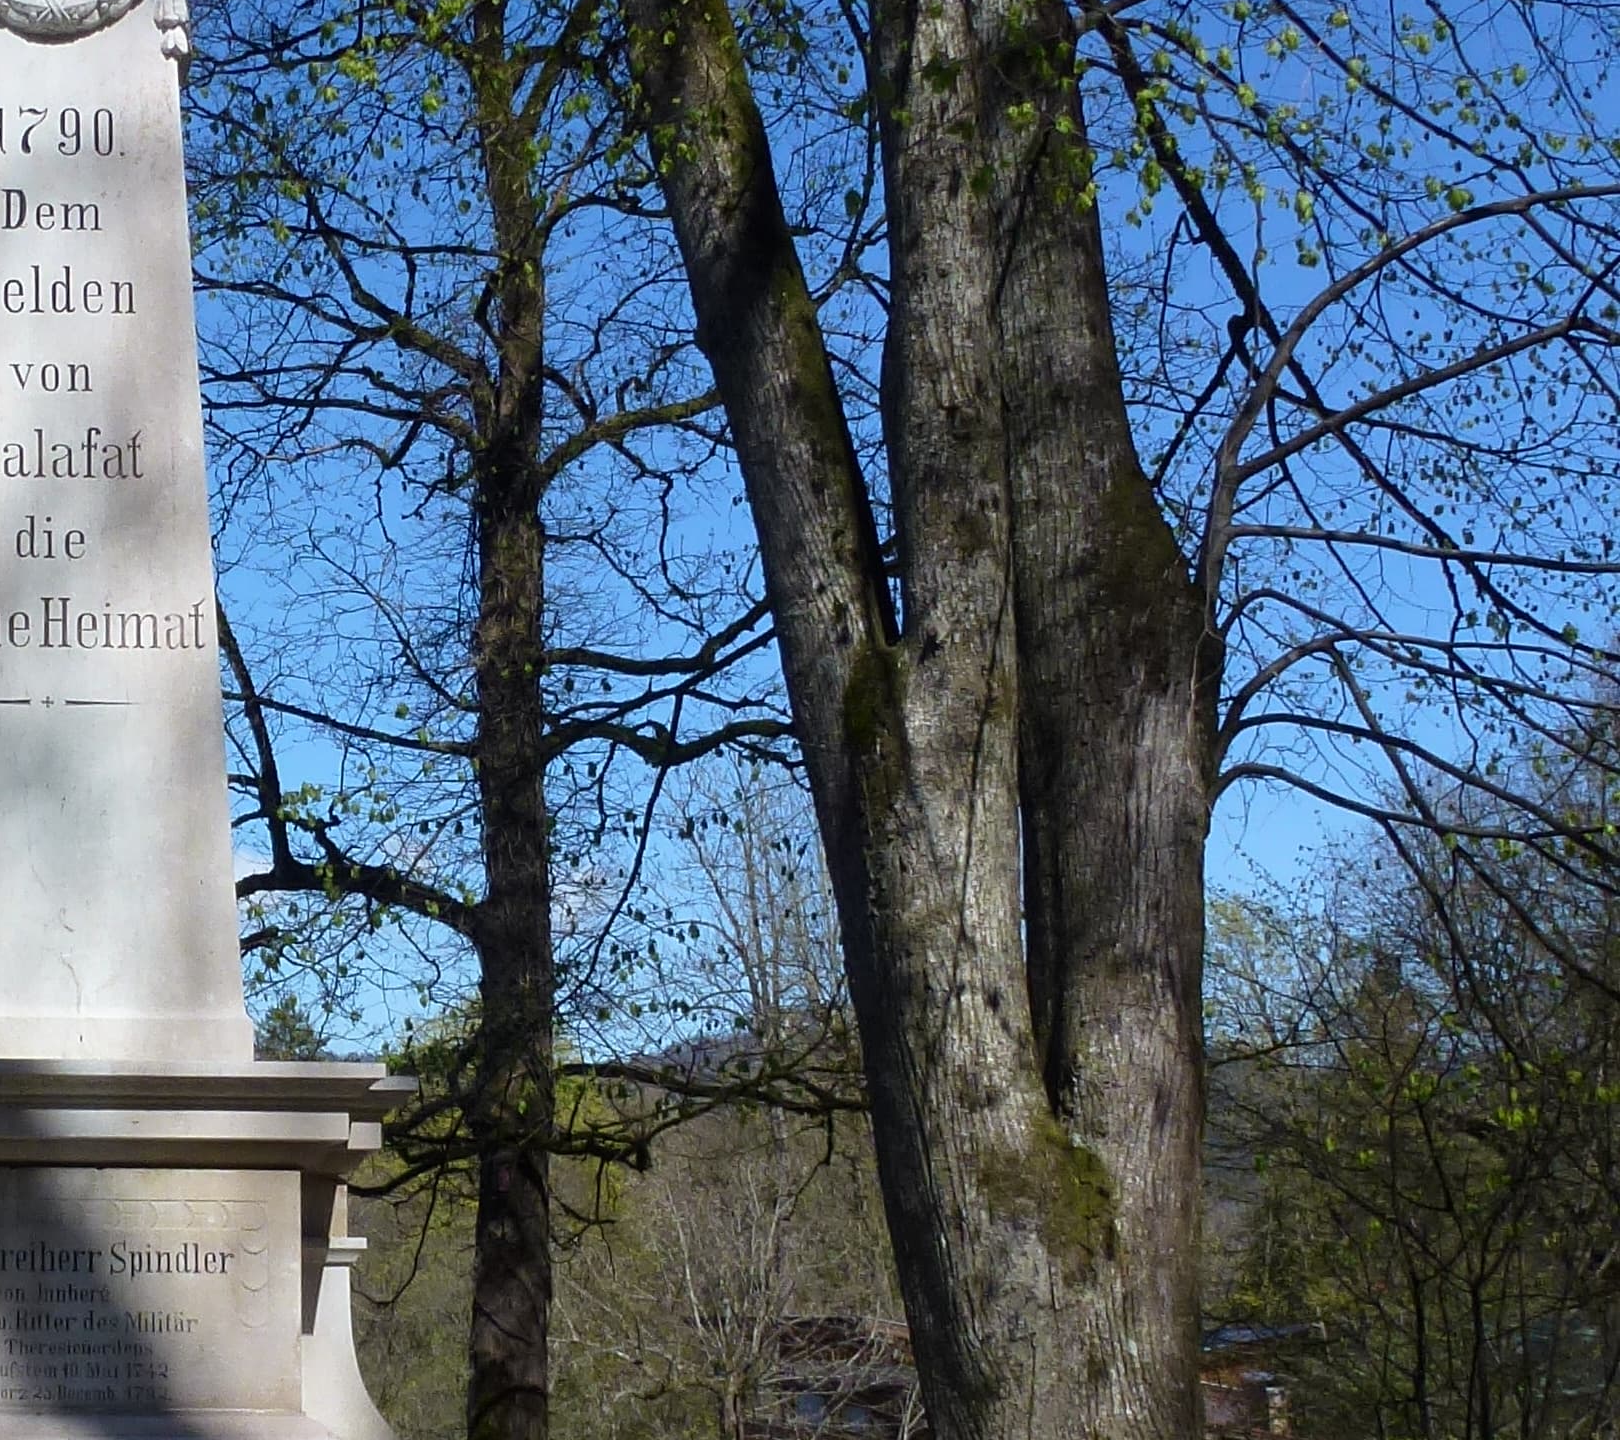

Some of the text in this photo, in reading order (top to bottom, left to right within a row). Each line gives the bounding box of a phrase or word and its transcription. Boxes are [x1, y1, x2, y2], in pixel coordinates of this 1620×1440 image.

[0, 187, 104, 232] Dem
[9, 361, 94, 394] von
[14, 514, 87, 561] die
[109, 1240, 235, 1281] Spindler
